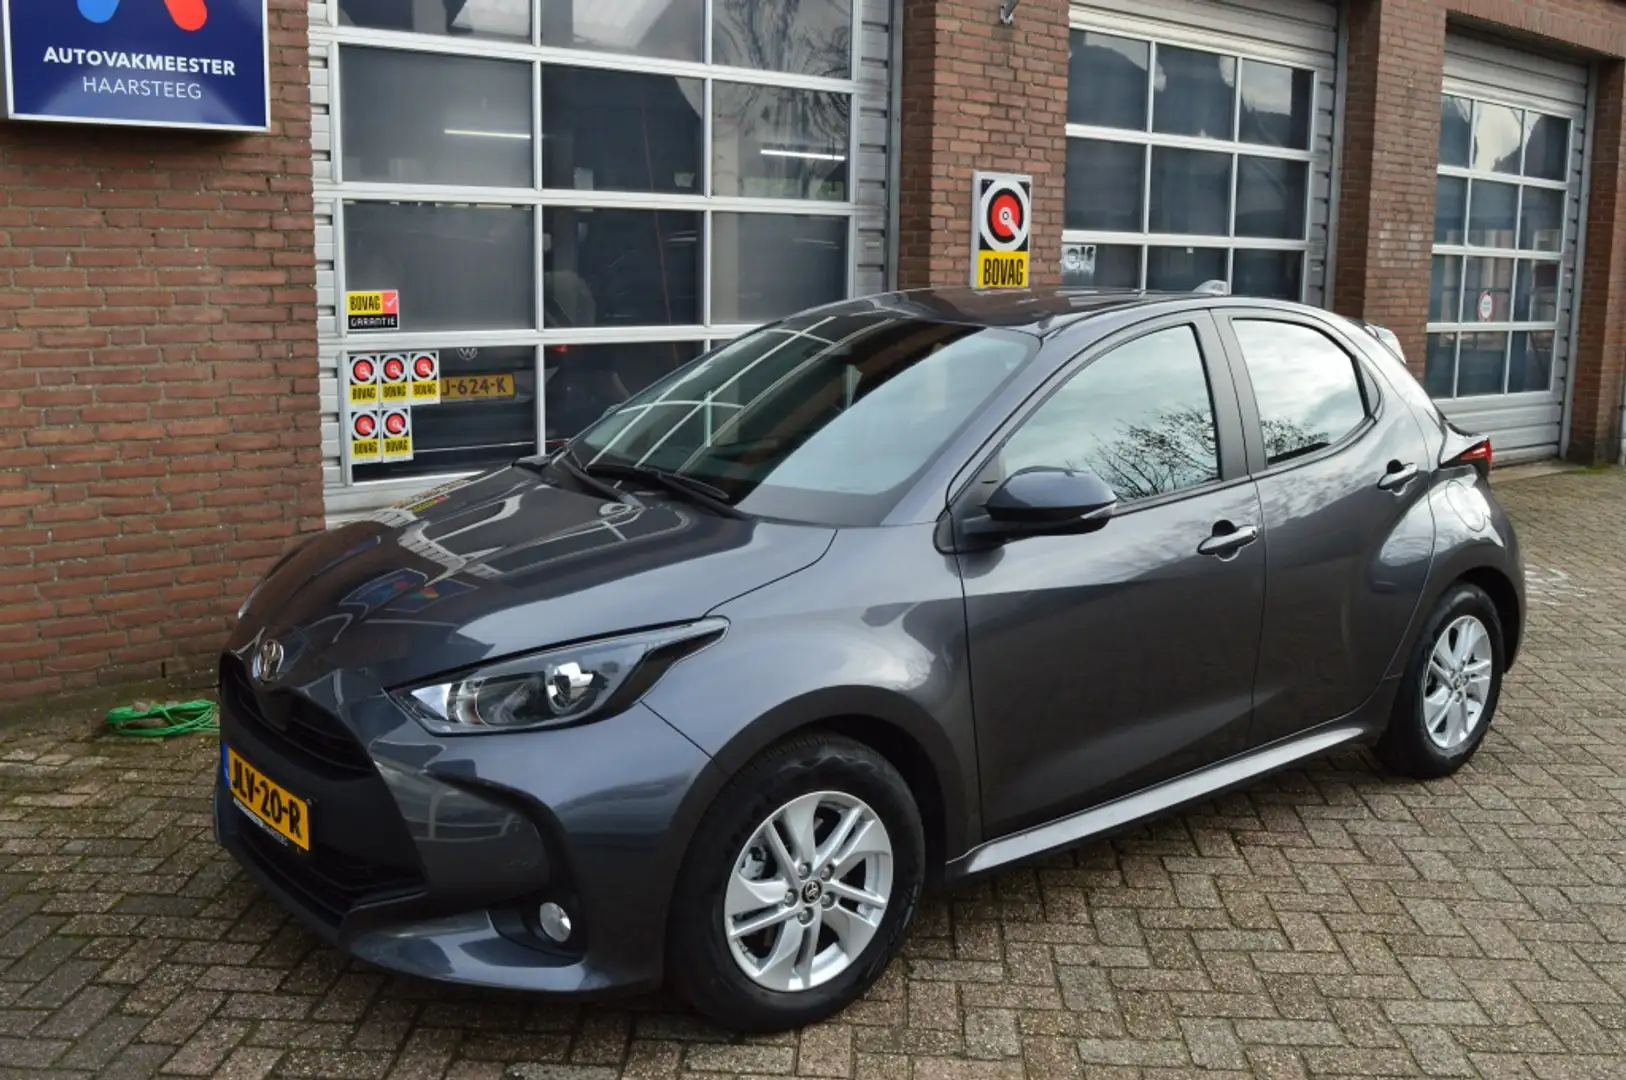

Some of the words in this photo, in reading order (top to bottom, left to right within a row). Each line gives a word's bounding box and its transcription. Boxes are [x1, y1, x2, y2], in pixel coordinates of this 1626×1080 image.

[43, 46, 236, 76] AUTOVAKMEESTER
[82, 76, 202, 99] HAARSTEEG
[983, 258, 1024, 286] BOVAG
[350, 295, 381, 311] BOVAG
[351, 387, 376, 400] BOVAG
[383, 385, 406, 398] BOVAG
[413, 383, 436, 396] BOVAG
[354, 442, 377, 455] BOVAG
[385, 440, 408, 453] BOVAG
[231, 758, 303, 841] JLV-20-R
